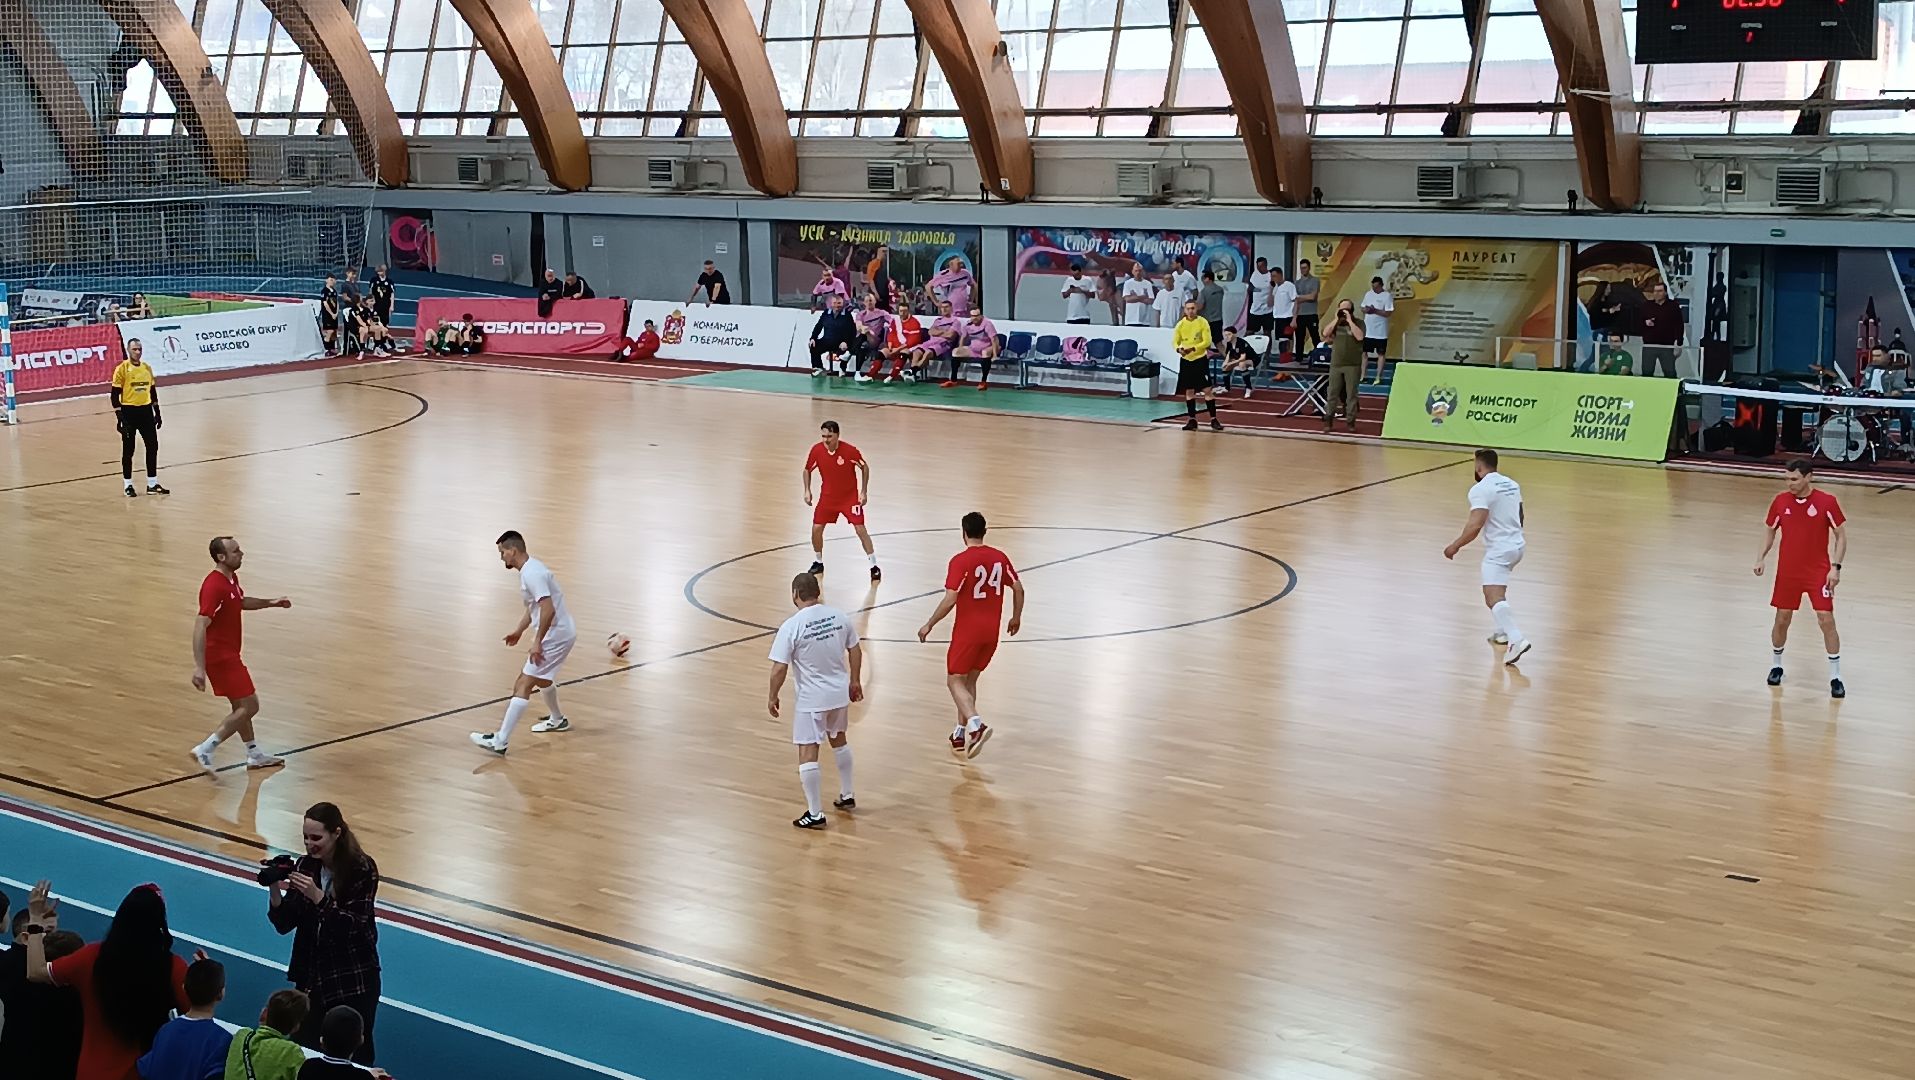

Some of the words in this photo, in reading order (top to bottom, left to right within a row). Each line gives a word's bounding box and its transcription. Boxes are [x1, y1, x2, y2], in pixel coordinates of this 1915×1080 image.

[1452, 250, 1516, 264] ЛАУРЕАТ
[195, 325, 256, 340] ГОРОДСКОЙ
[257, 323, 288, 335] ОКРУГ
[693, 320, 739, 332] КОМАНДА
[1470, 394, 1538, 409] МИНСПОРТ
[1466, 410, 1518, 424] РОССИИ
[1574, 409, 1631, 427] НОРМА
[1570, 425, 1627, 442] ЖИЗНИ
[973, 561, 1003, 599] 24
